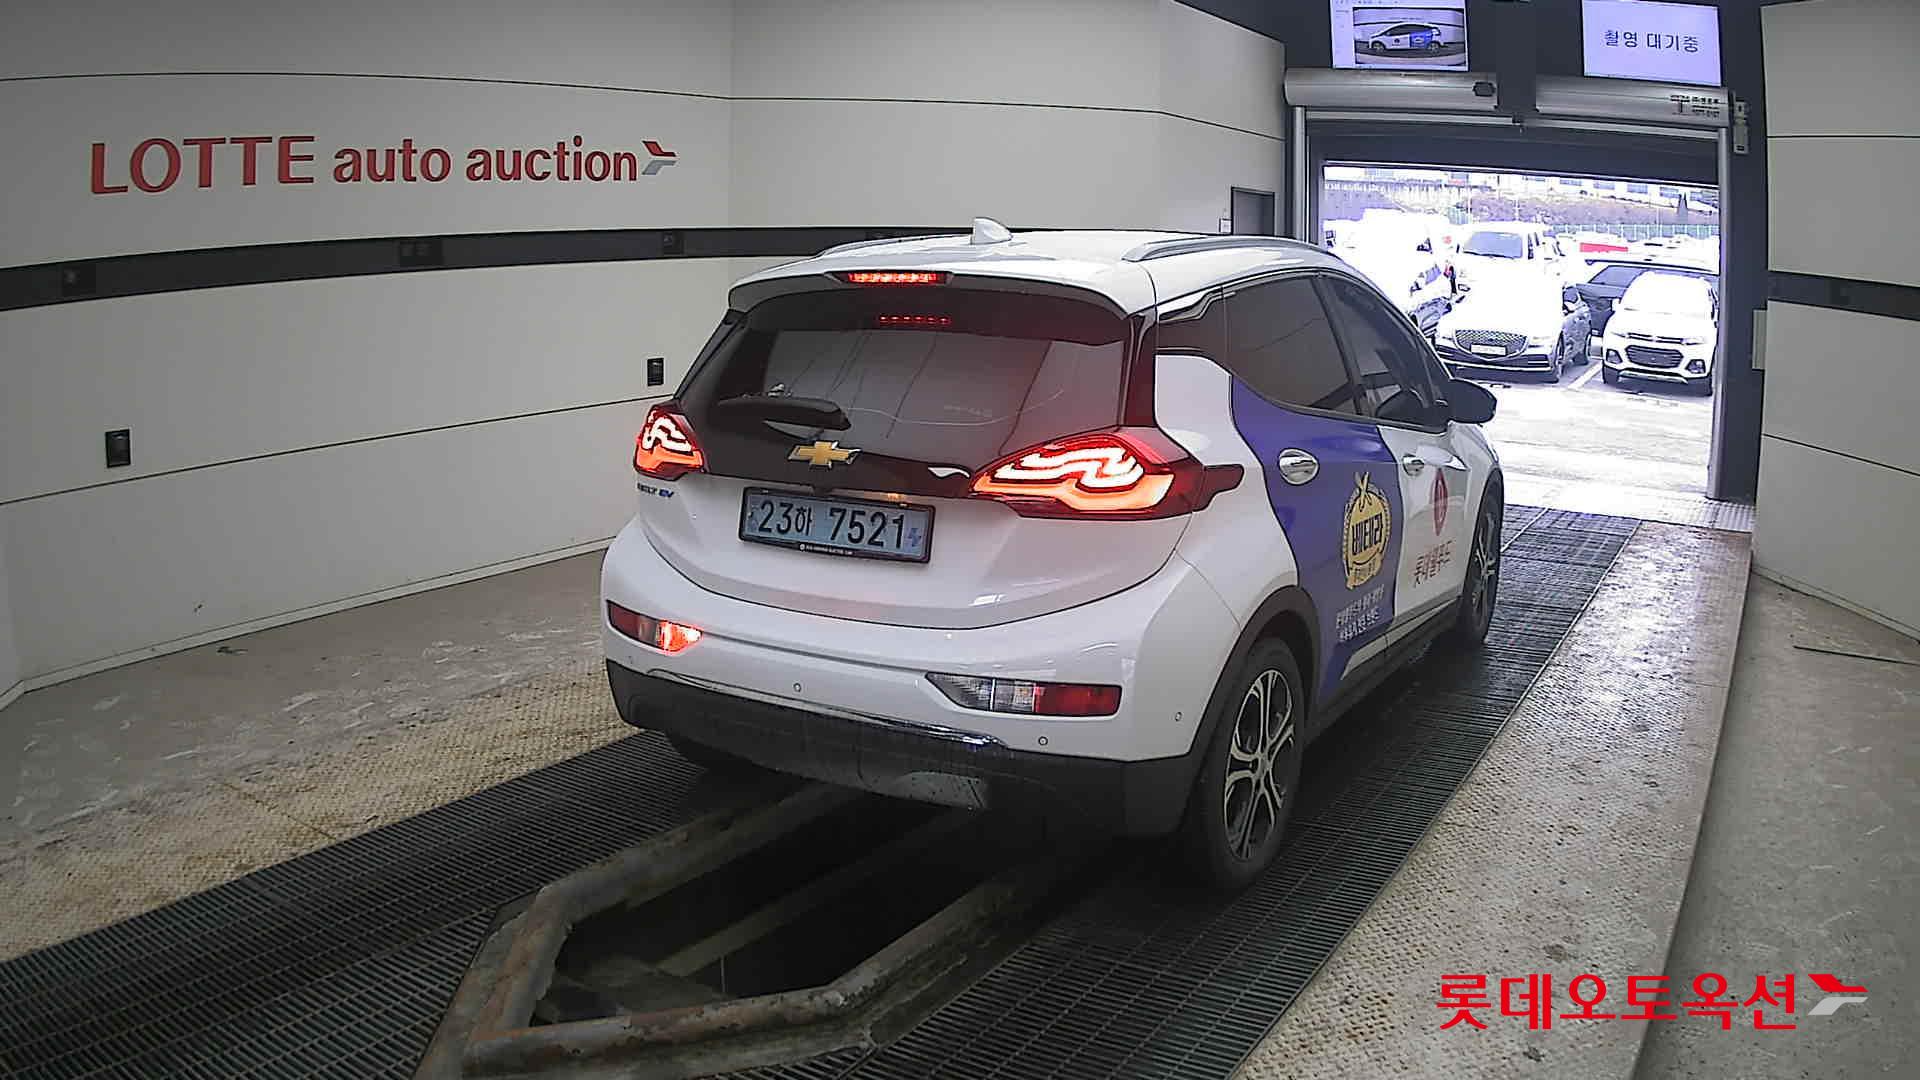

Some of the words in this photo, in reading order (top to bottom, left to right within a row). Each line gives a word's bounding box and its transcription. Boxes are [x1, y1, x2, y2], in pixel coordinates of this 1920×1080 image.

[1646, 33, 1699, 53] 대기중
[91, 136, 315, 195] LOTTE
[333, 138, 451, 182] auto
[466, 135, 638, 181] auction
[758, 501, 812, 536] 23하
[829, 507, 905, 549] 7521
